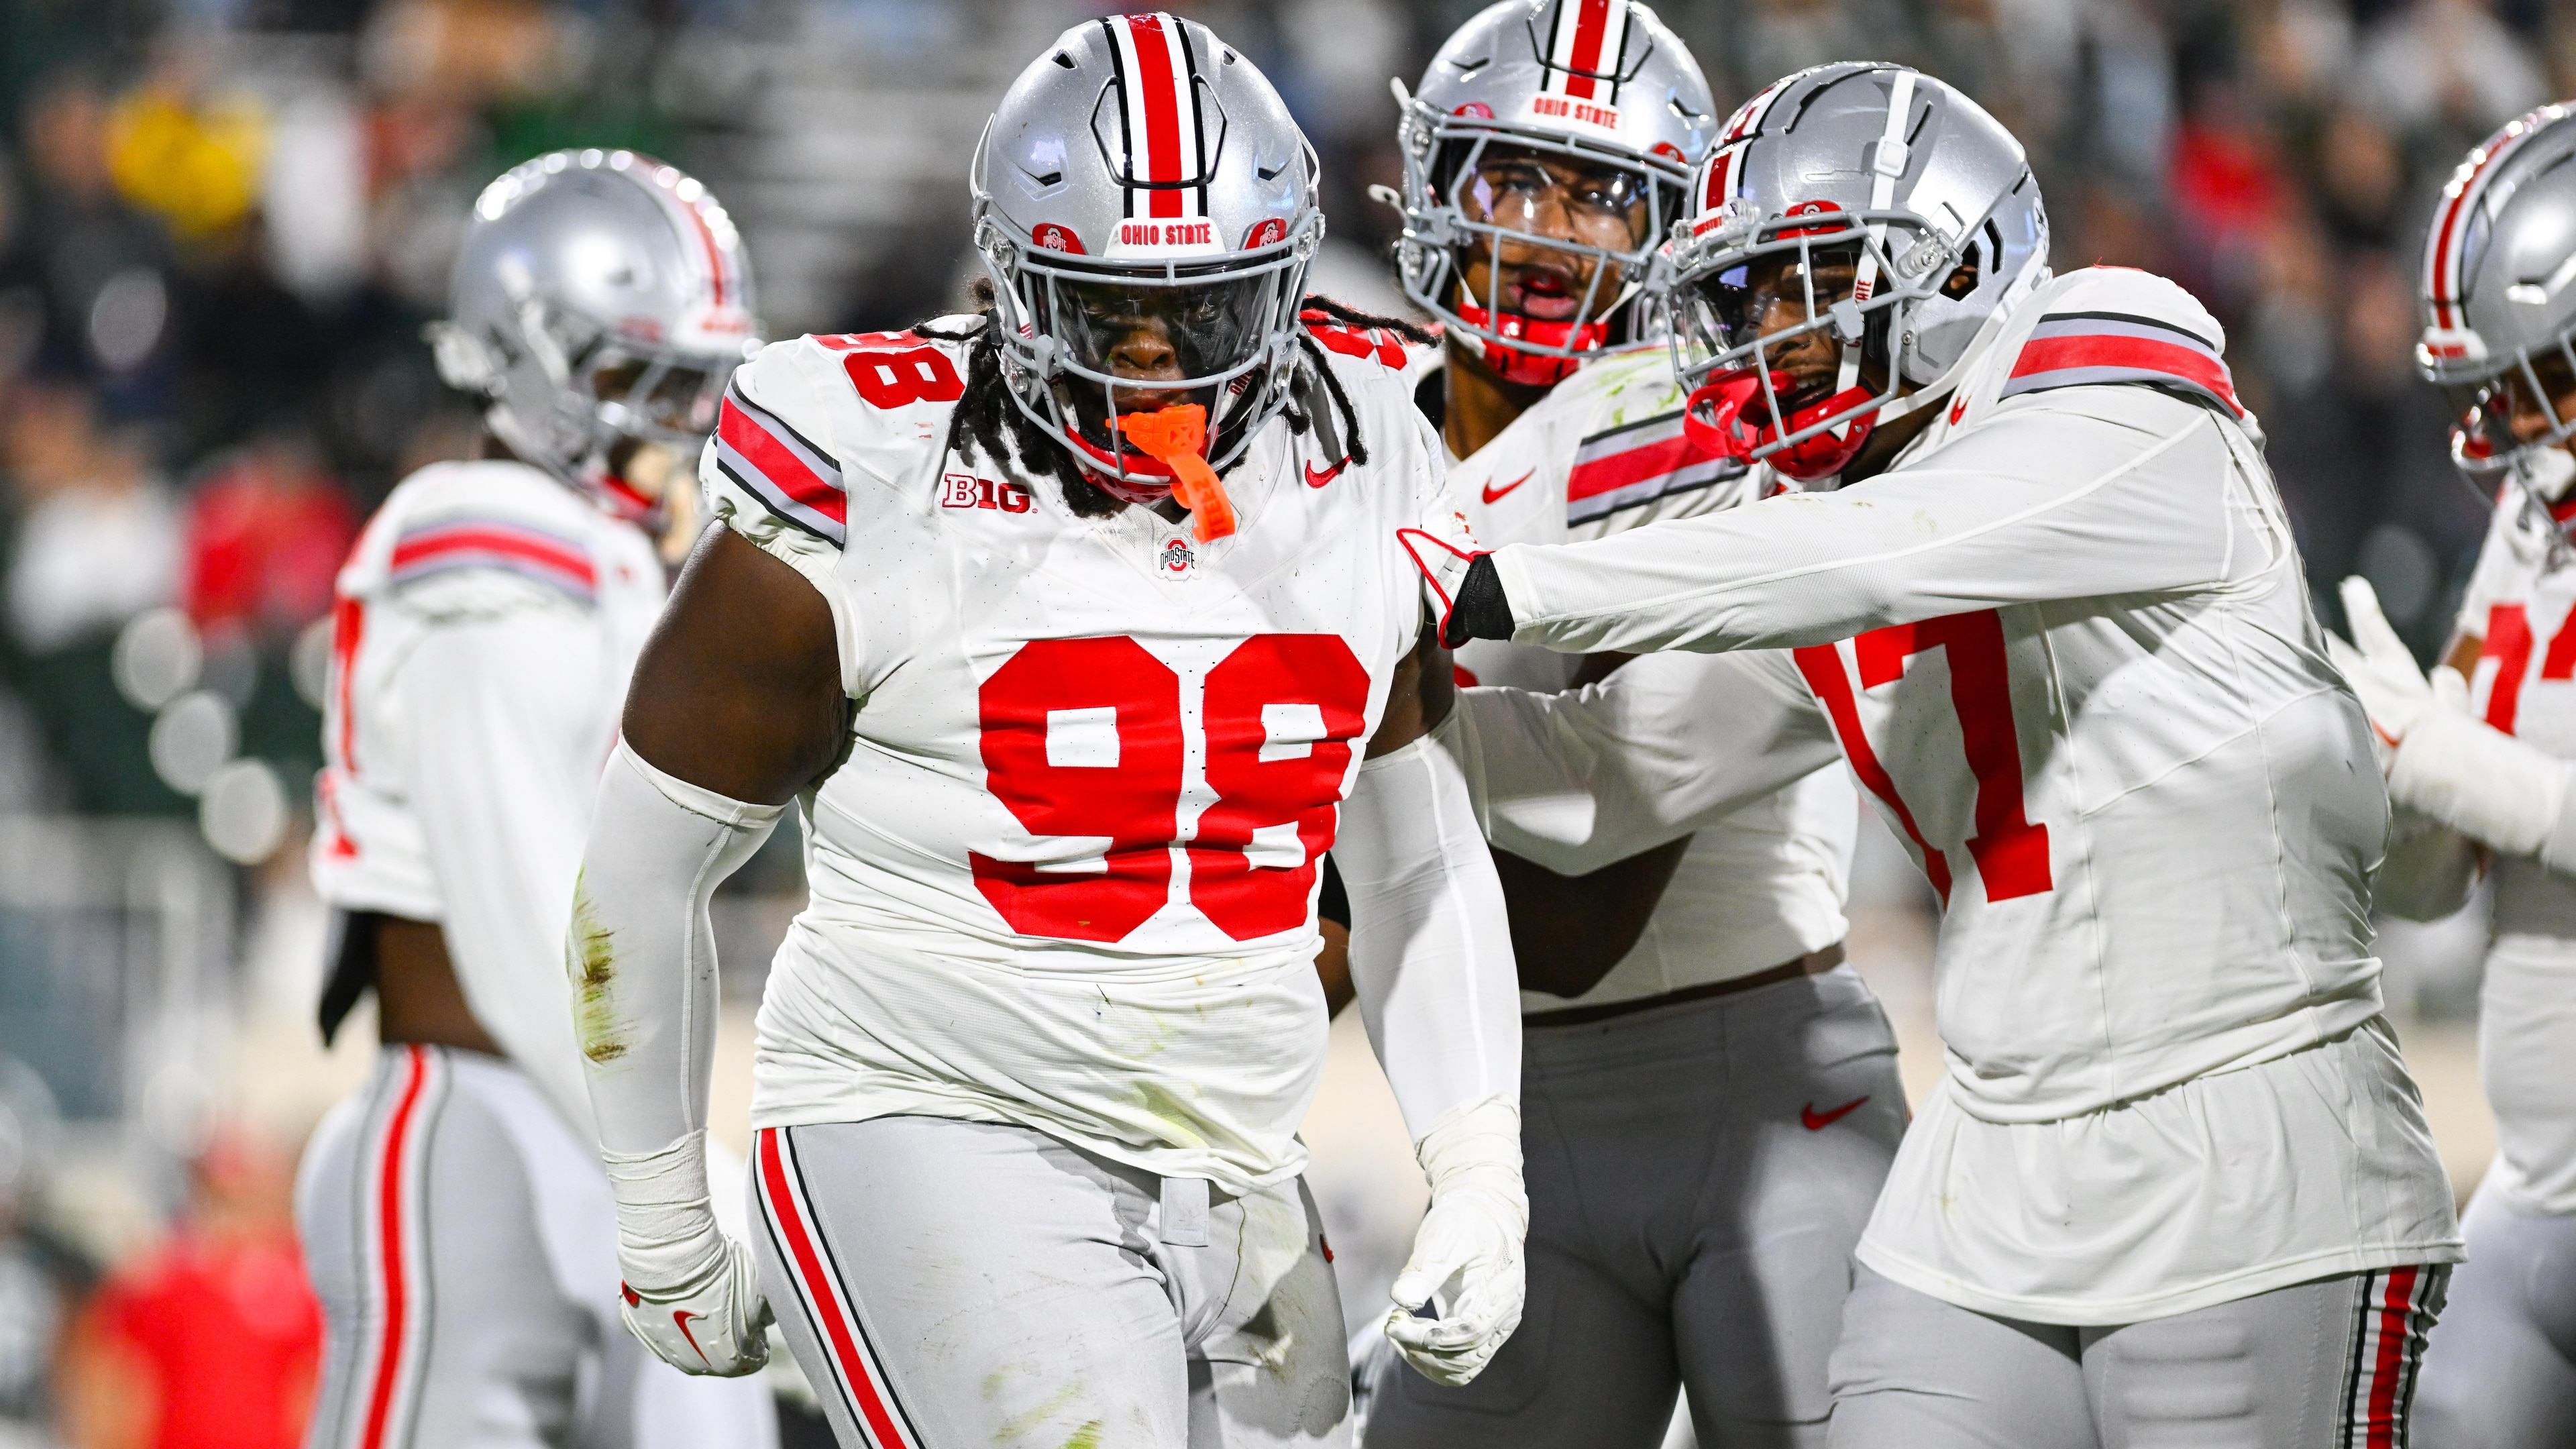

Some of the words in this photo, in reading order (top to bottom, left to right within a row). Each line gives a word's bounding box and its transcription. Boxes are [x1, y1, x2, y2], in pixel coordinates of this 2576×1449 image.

[1534, 97, 1569, 117] OHIO
[1574, 104, 1618, 129] STATE
[1122, 224, 1159, 246] OHIO
[1166, 223, 1212, 246] STATE
[1854, 279, 1872, 304] ATE
[968, 633, 1371, 943] 98
